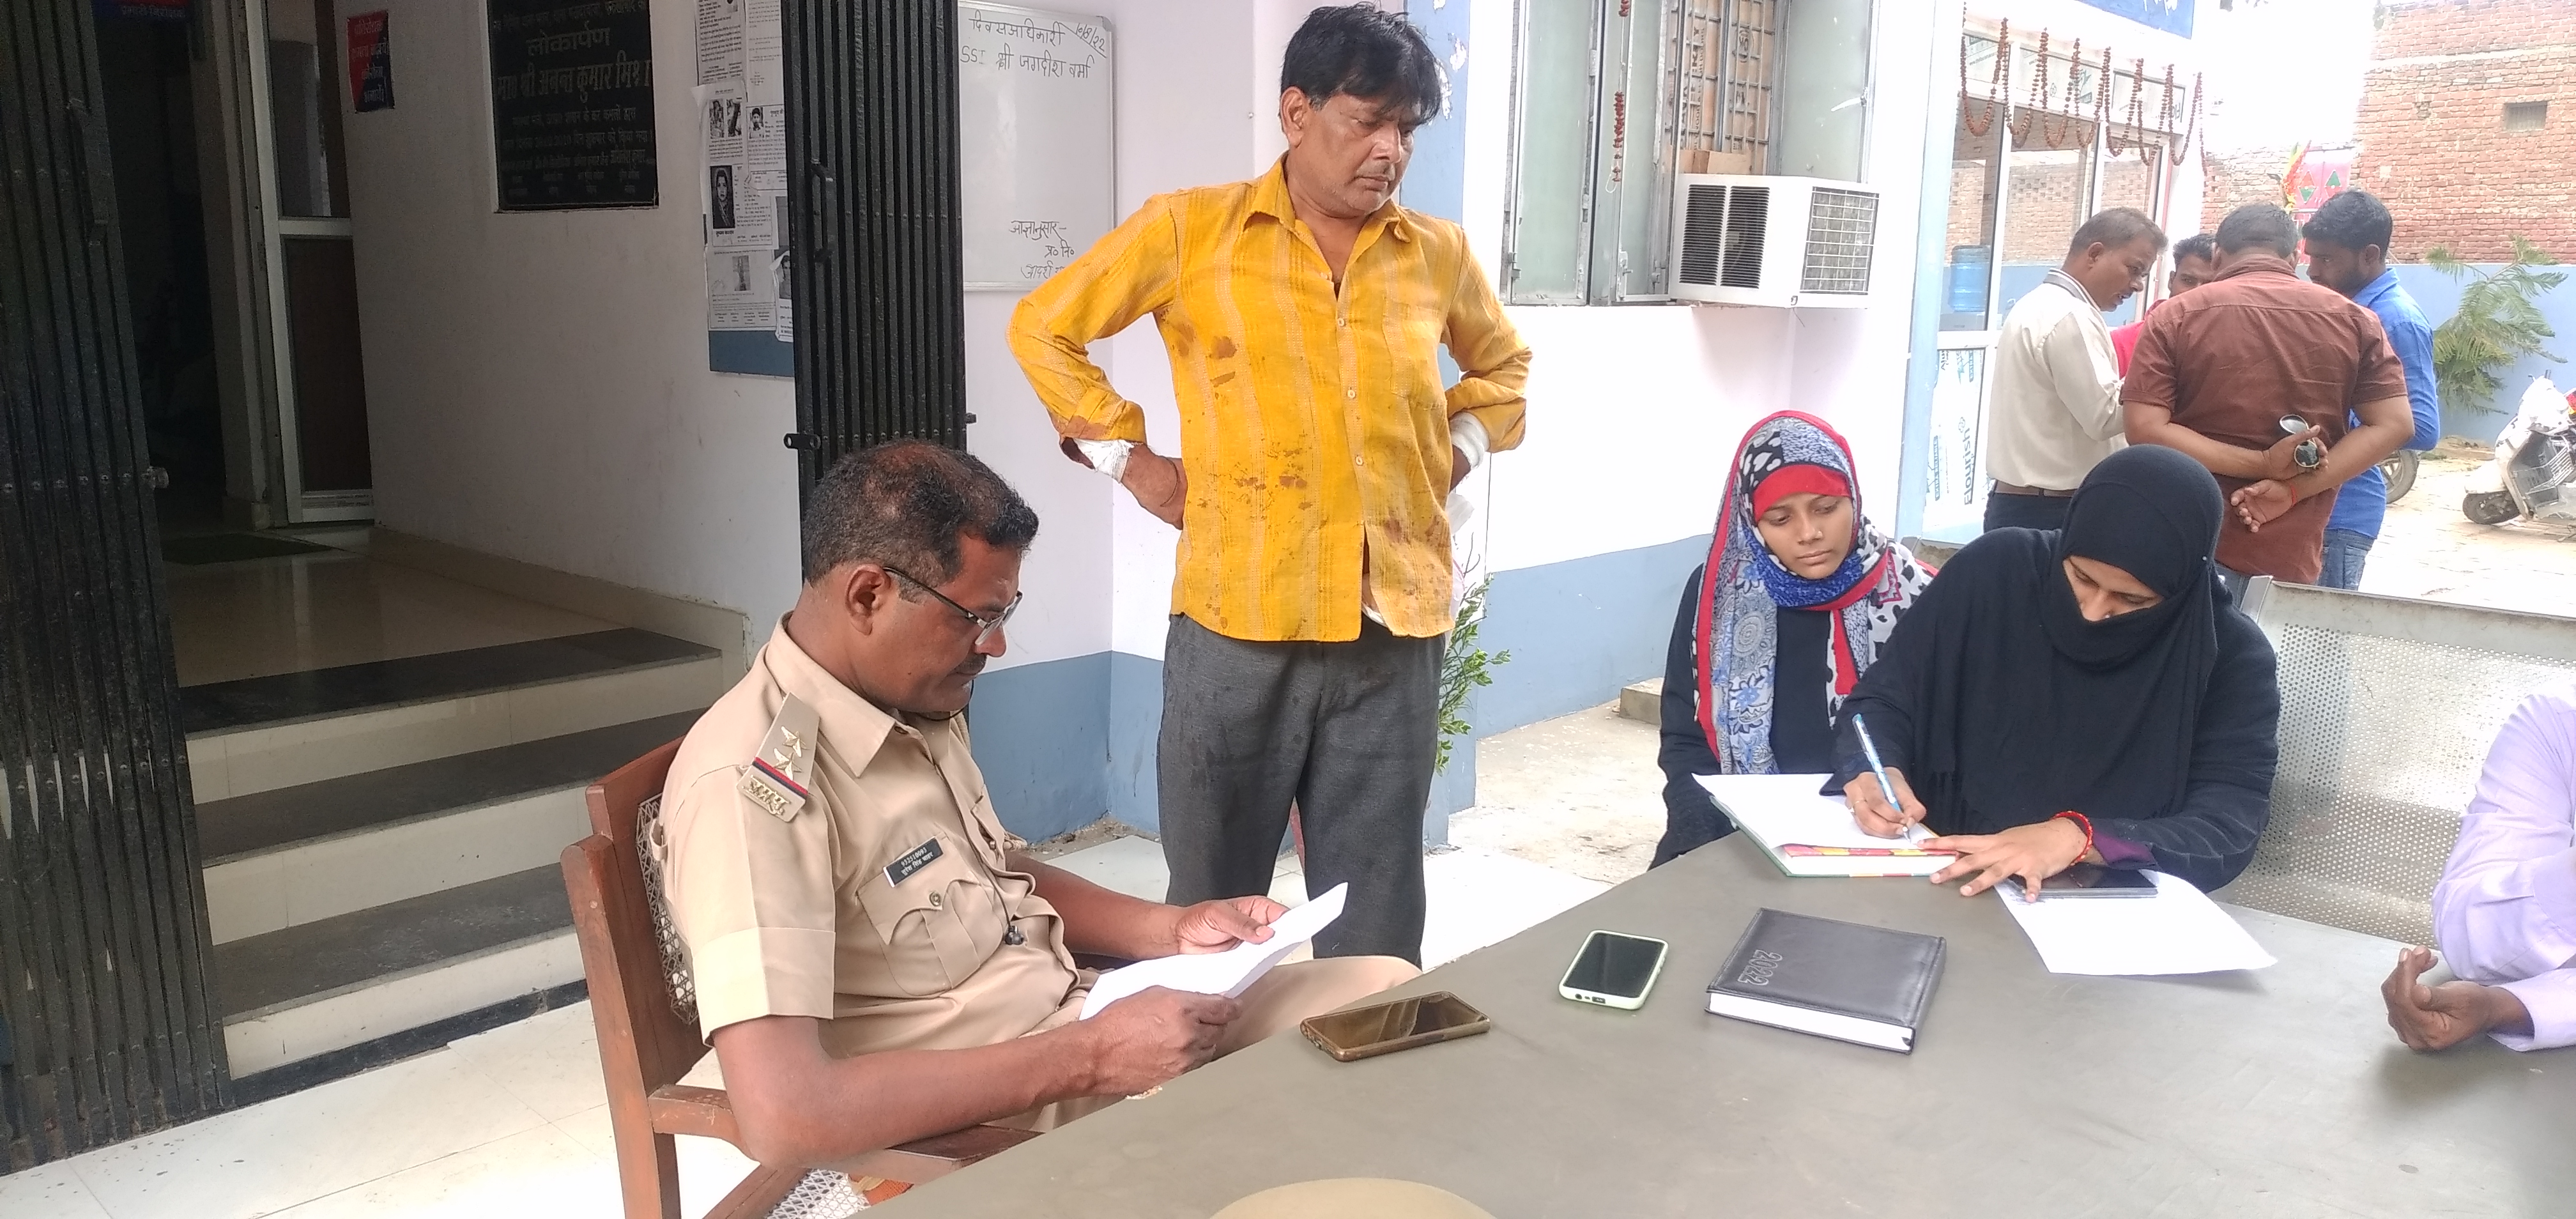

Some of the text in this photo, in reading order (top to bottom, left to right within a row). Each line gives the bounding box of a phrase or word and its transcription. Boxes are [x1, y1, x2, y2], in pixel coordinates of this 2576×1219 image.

[996, 42, 1014, 70] श्री
[1020, 50, 1066, 77] जगदीश
[1069, 54, 1094, 78] वर्मा
[577, 63, 613, 103] कुमार
[1962, 427, 1972, 505] Flourish
[1738, 949, 1782, 985] 2022
